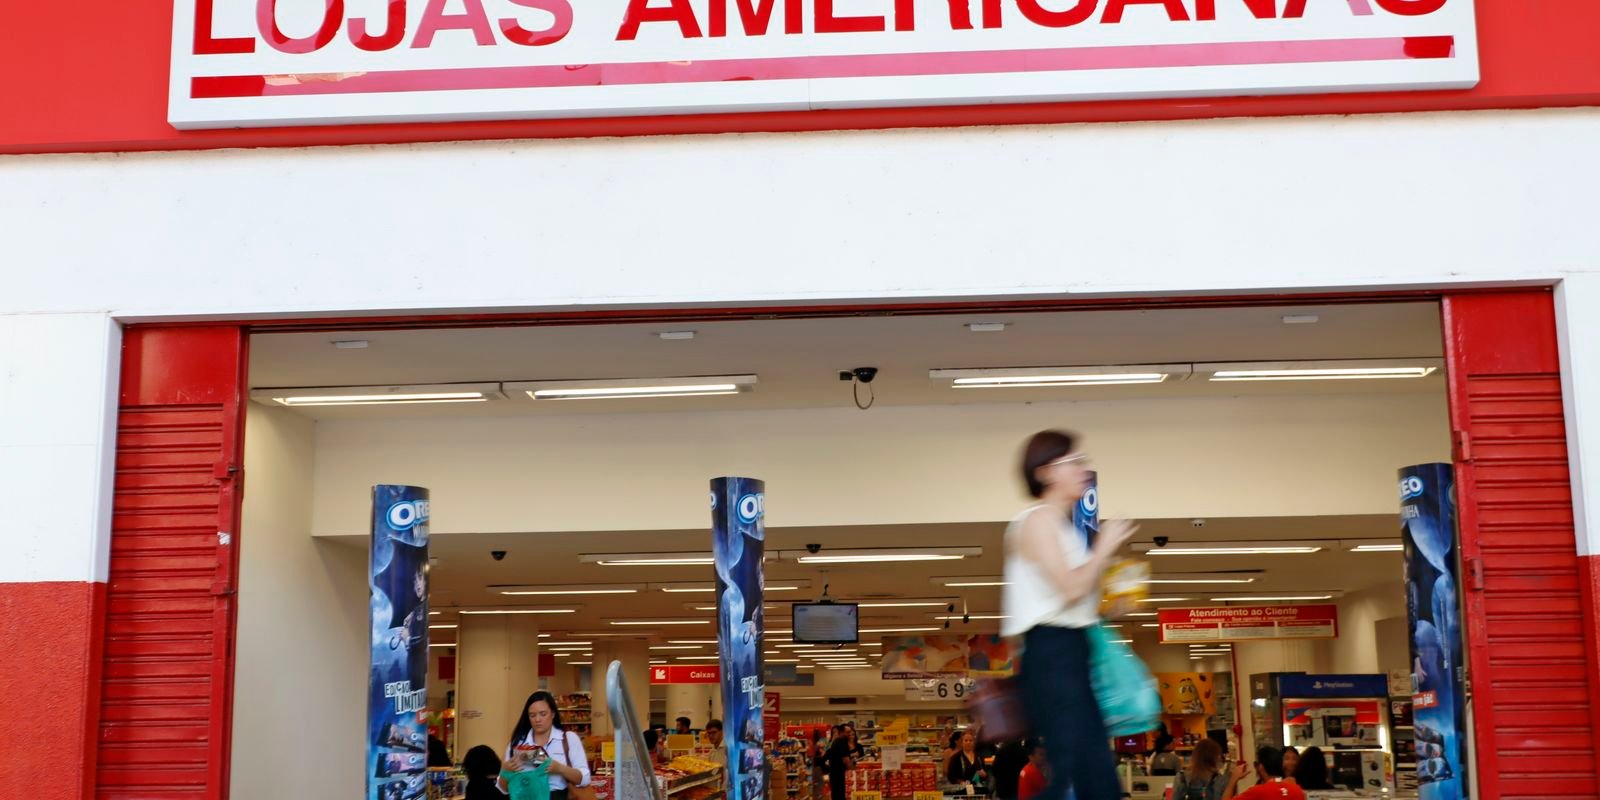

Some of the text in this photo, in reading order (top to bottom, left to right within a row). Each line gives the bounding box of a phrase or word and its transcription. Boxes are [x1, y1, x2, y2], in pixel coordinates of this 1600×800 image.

[191, 0, 1449, 55] LOJAS AMERI
[1189, 608, 1249, 617] Atendimento
[1264, 607, 1298, 615] Cliente
[690, 671, 715, 679] Caixas
[937, 683, 948, 698] 6
